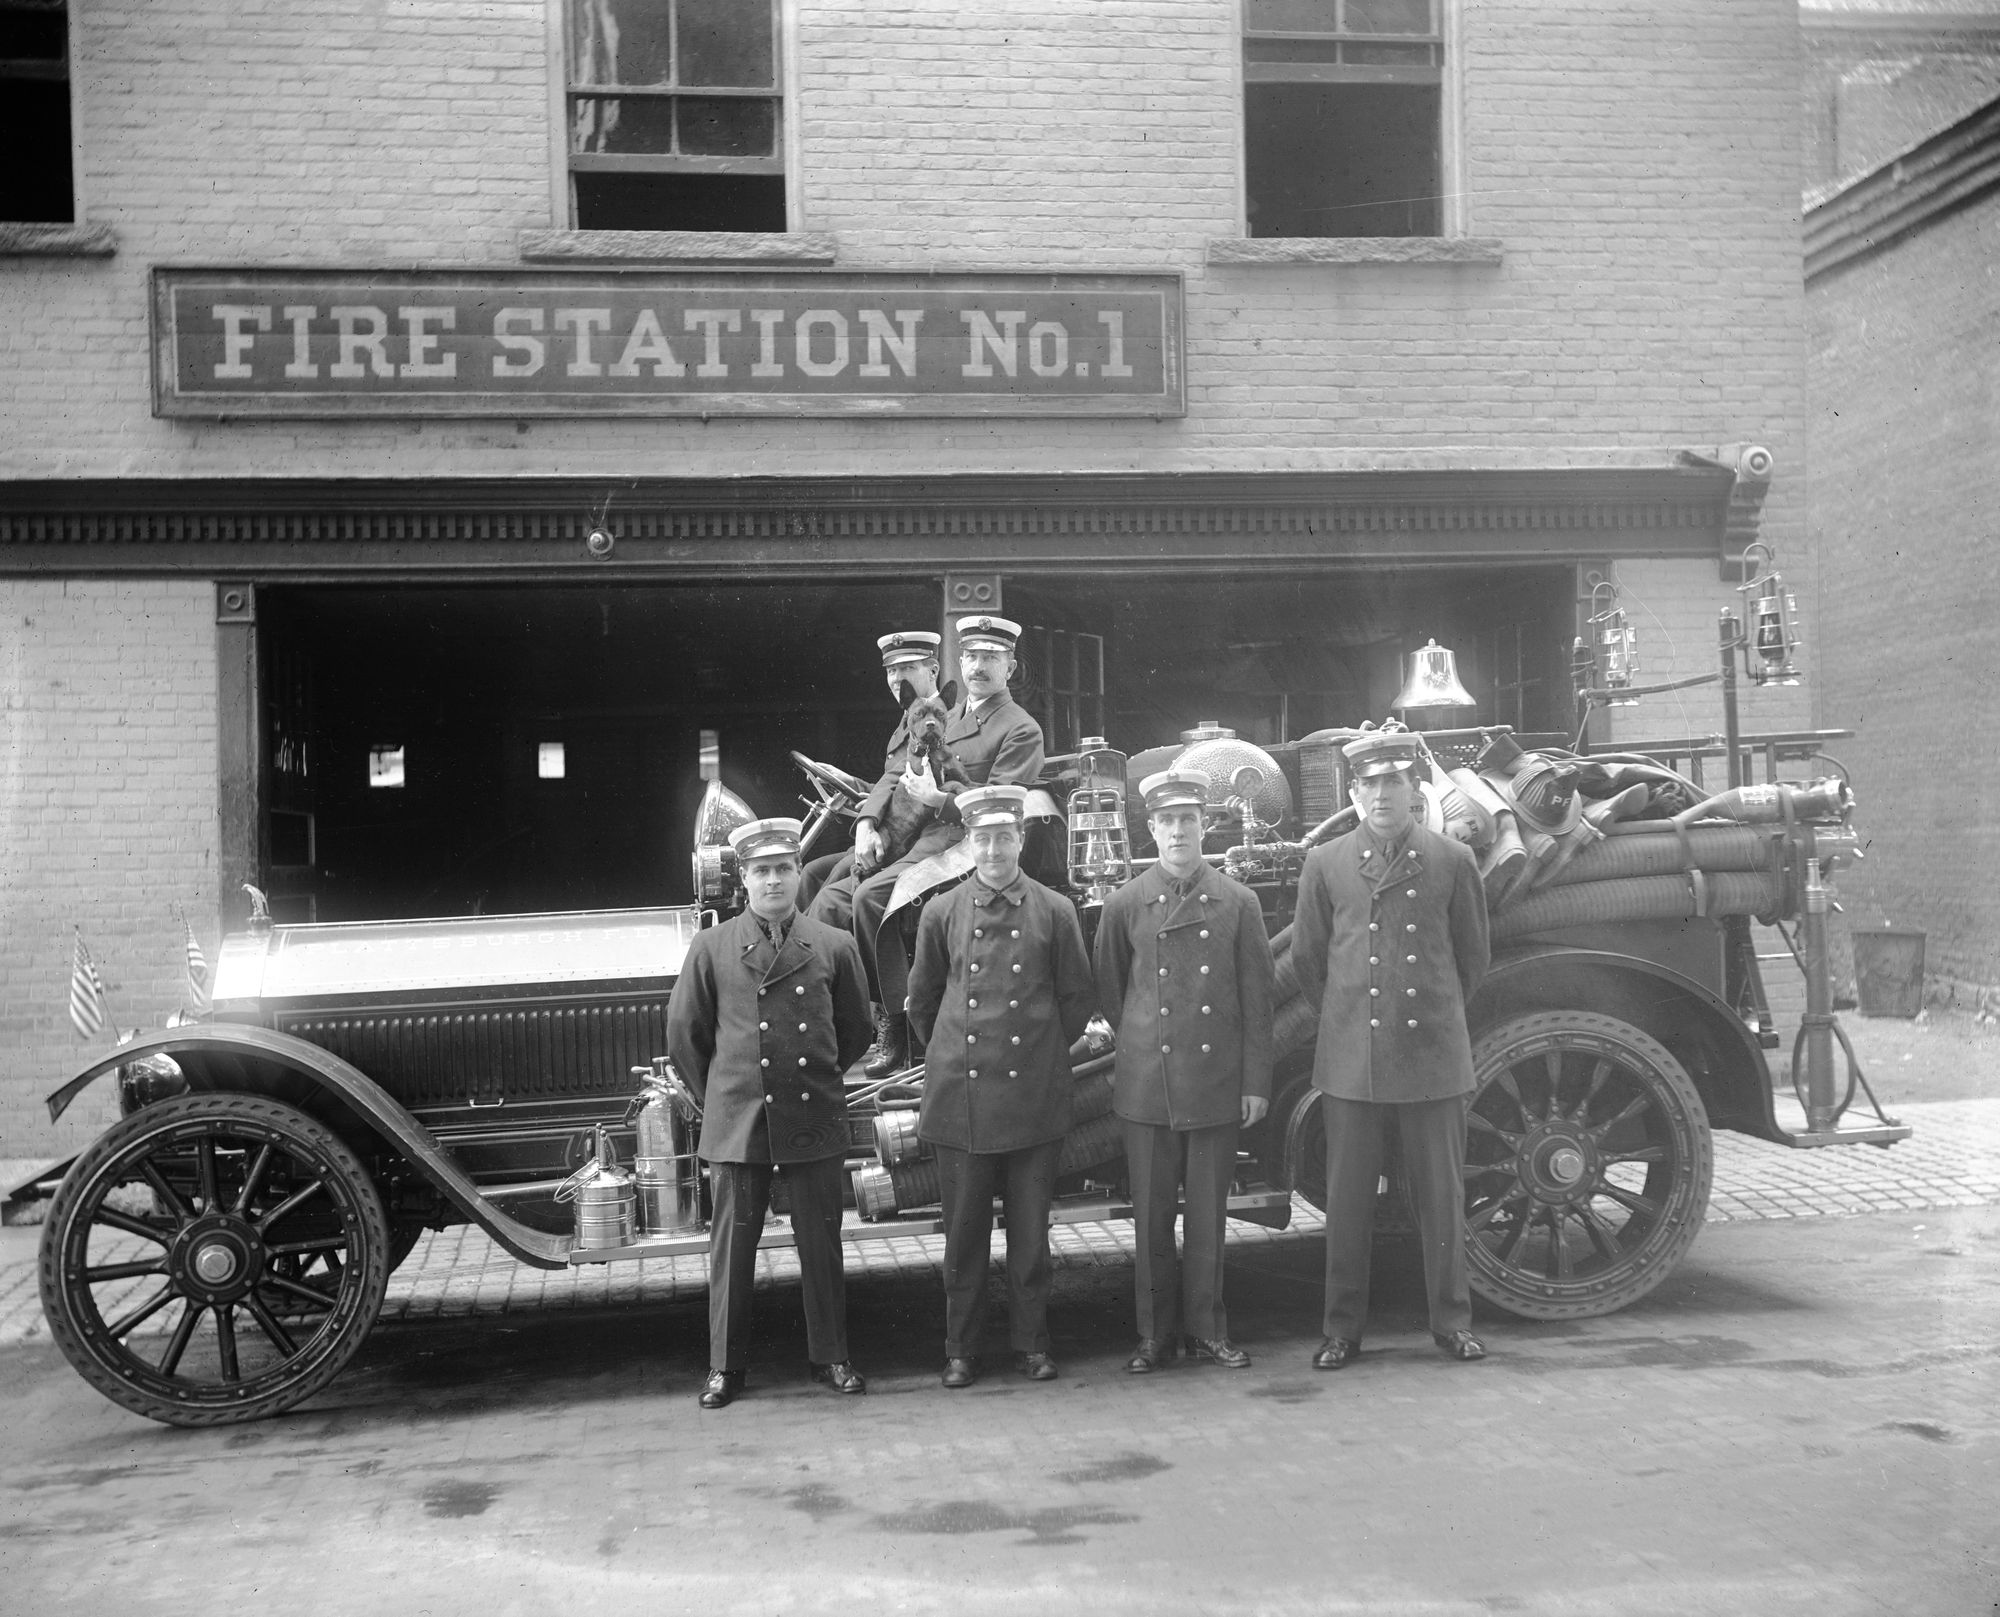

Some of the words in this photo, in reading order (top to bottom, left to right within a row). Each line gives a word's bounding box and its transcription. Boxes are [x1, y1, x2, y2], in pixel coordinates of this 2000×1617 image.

[211, 304, 457, 378] FIRE
[492, 307, 924, 378] STATION
[305, 930, 584, 955] PLATTSBURGH
